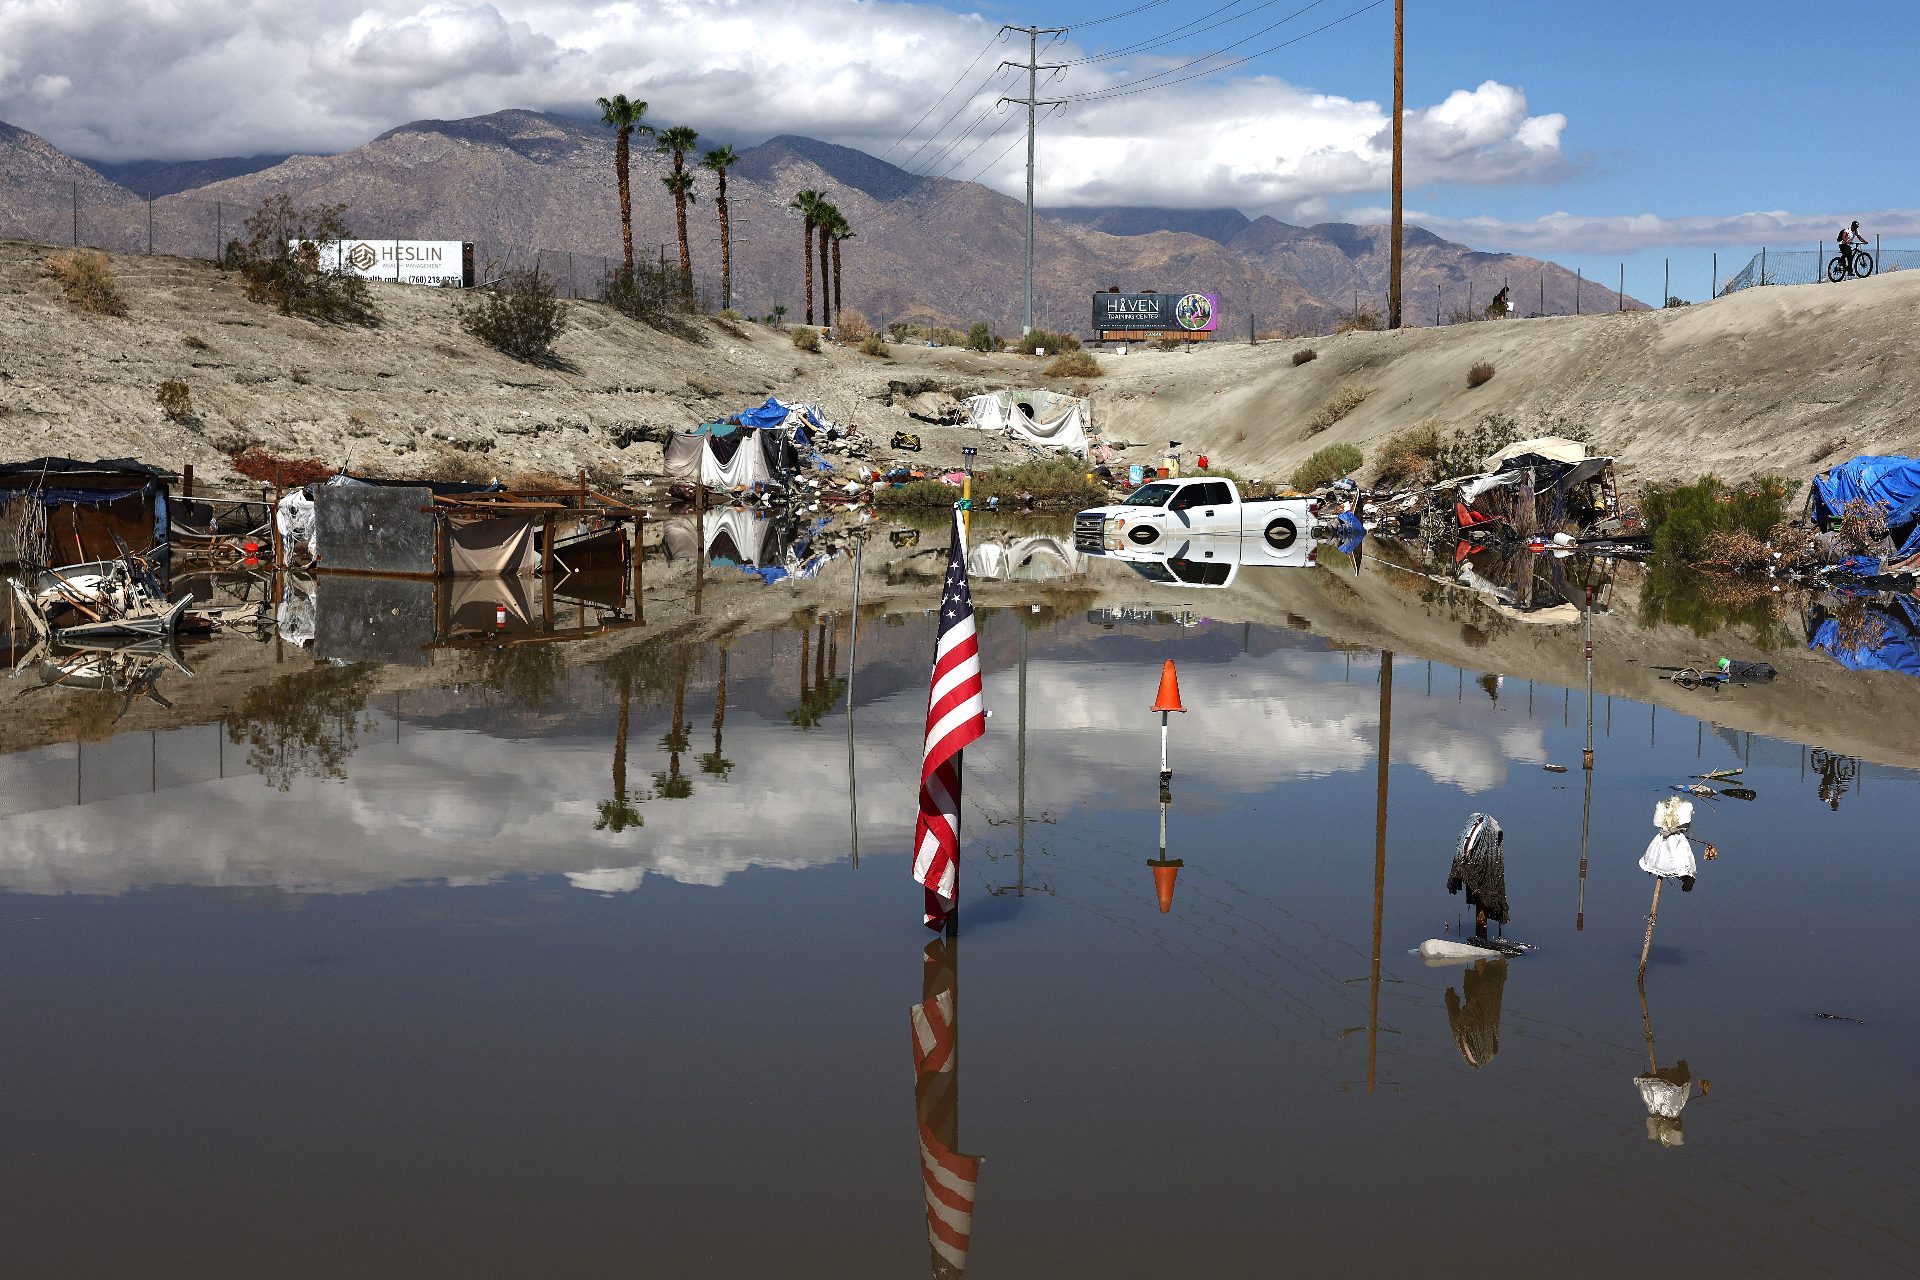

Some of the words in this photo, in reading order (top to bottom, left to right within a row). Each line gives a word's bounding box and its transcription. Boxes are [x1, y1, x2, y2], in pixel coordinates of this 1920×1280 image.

[382, 246, 442, 261] HESLIN
[408, 275, 427, 284] (760)
[1107, 298, 1159, 311] HAVEN
